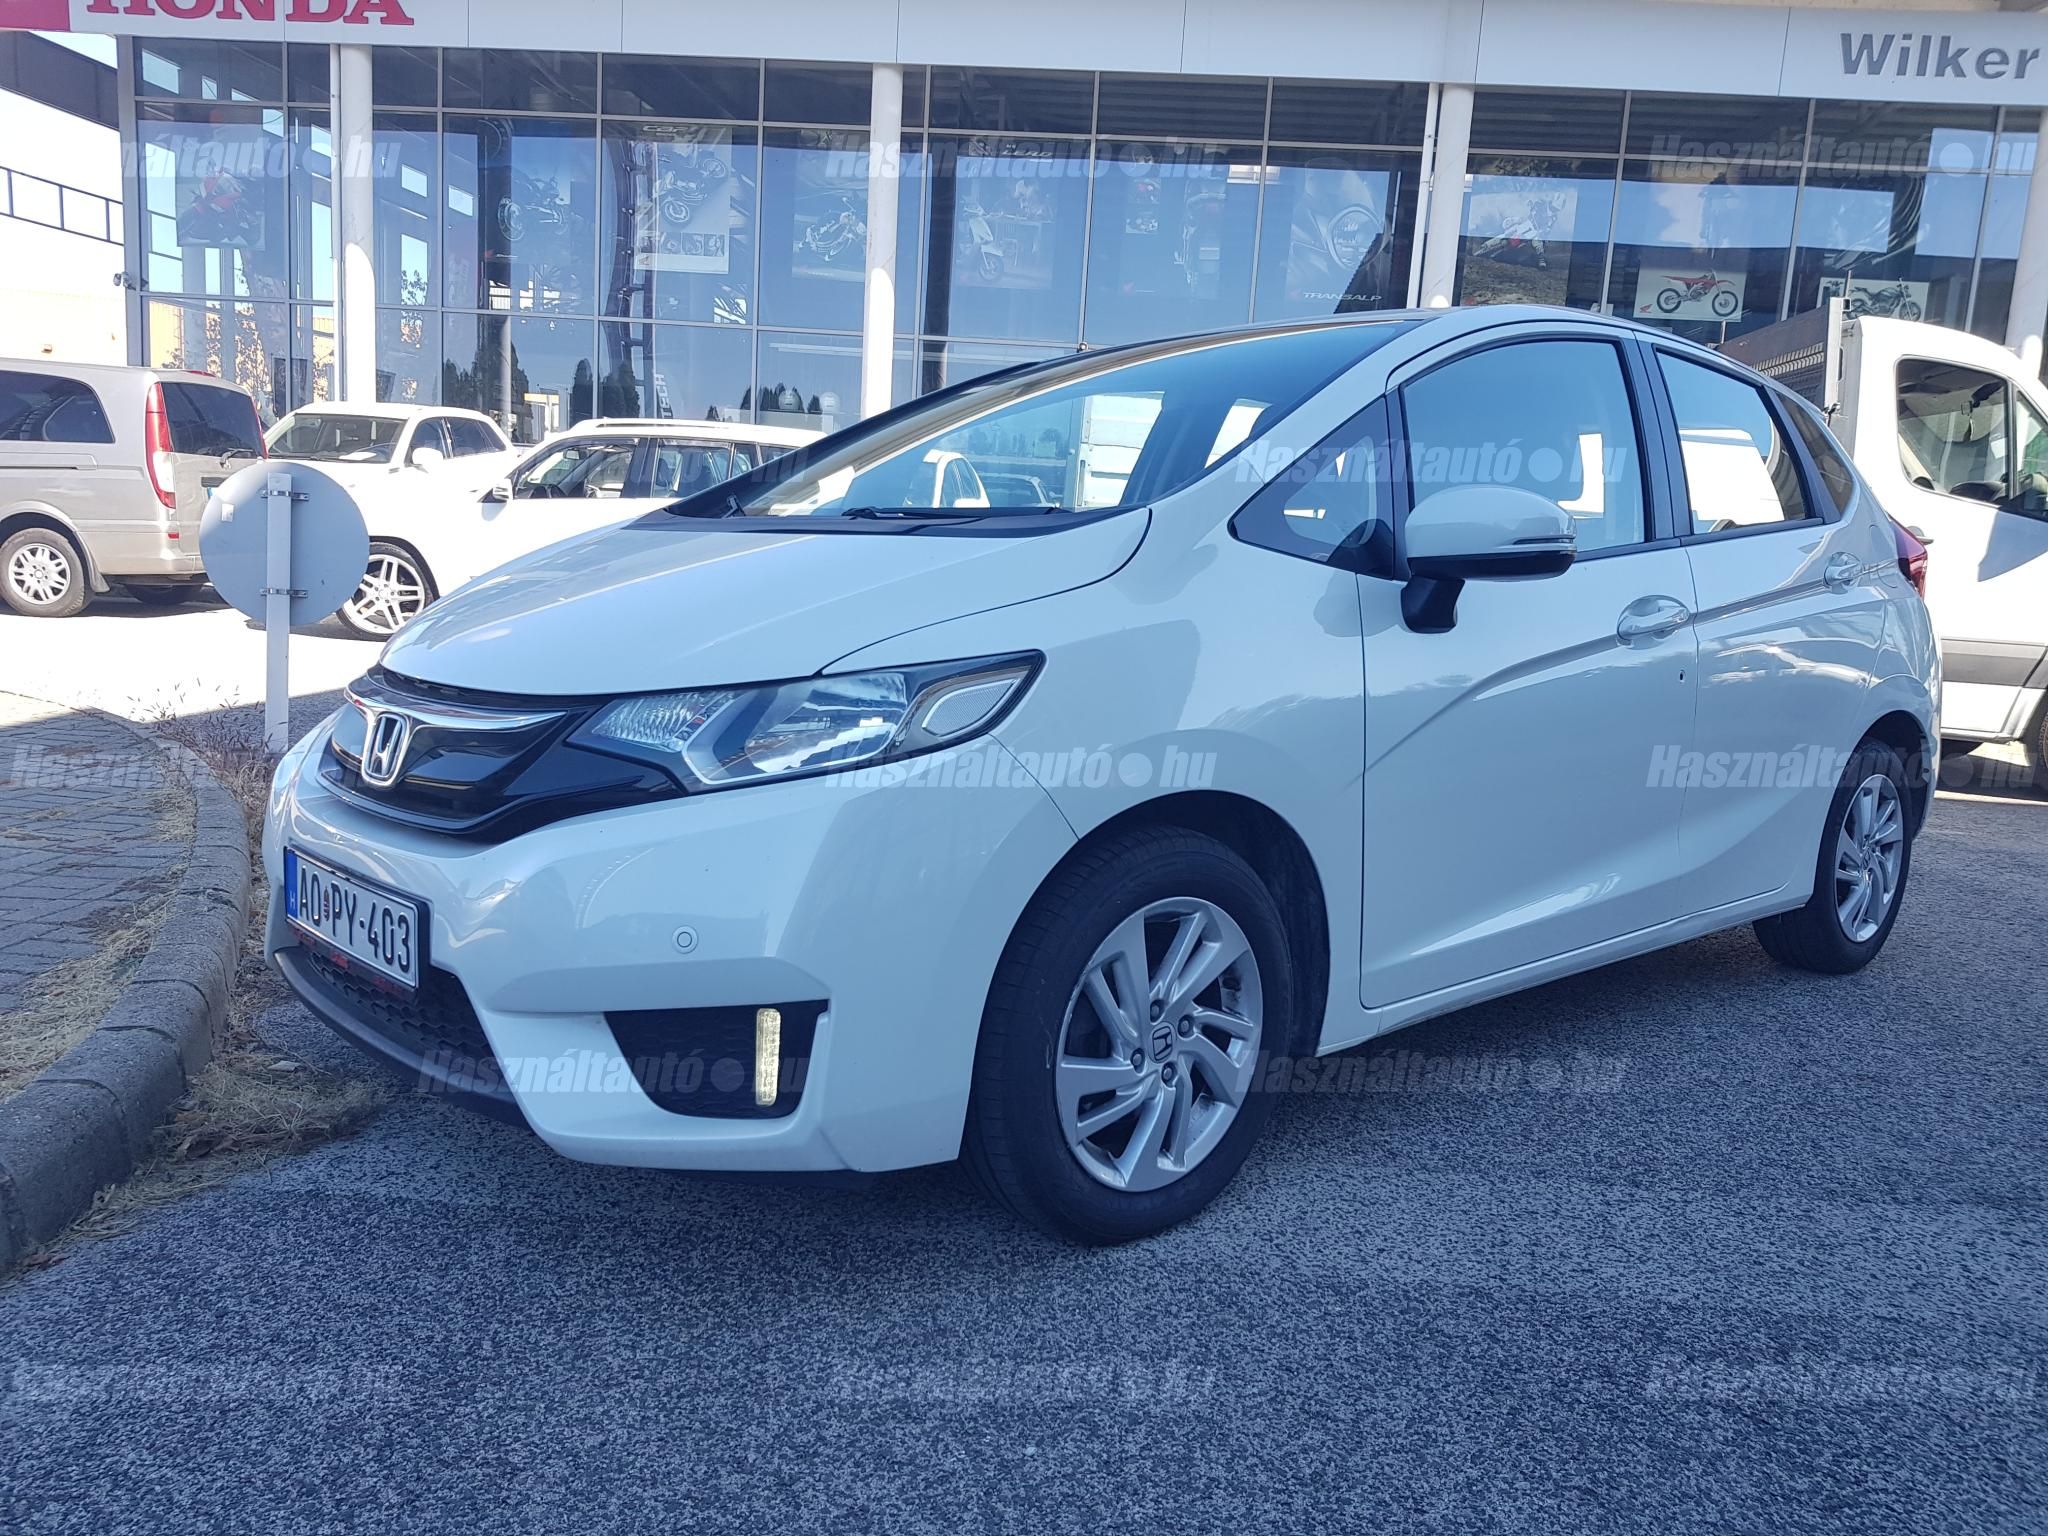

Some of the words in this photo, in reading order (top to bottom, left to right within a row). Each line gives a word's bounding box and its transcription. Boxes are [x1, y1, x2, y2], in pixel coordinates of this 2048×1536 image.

[87, 0, 415, 25] NDA
[1840, 33, 2041, 79] Wilker
[1303, 291, 1382, 301] TRANSALP
[331, 880, 410, 974] PY-403
